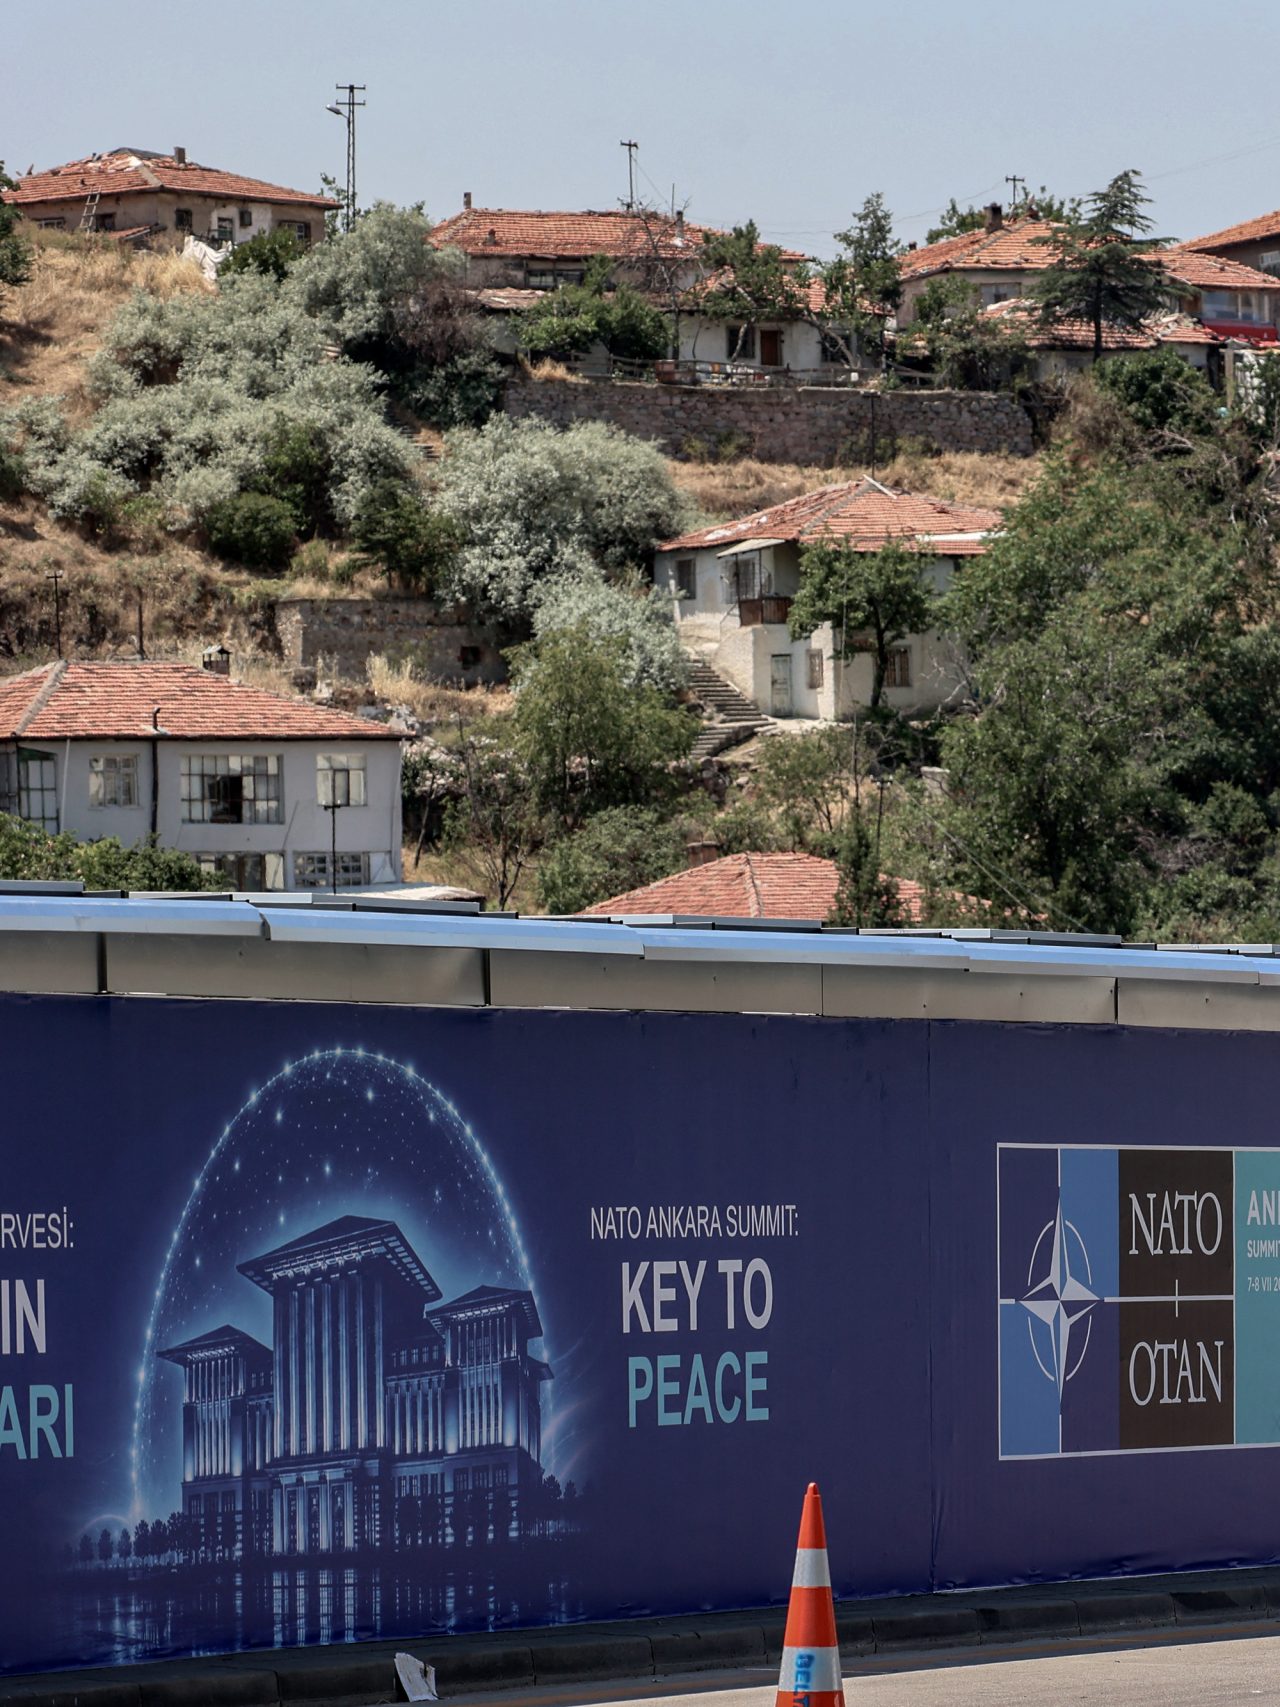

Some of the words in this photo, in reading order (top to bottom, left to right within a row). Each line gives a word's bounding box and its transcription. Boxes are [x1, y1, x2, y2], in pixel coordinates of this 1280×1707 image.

[591, 1206, 641, 1239] NATO
[645, 1205, 722, 1238] ANKARA
[726, 1204, 799, 1237] SUMMIT:
[1128, 1190, 1223, 1256] NATO
[621, 1260, 707, 1333] KEY
[718, 1257, 773, 1330] TO
[1247, 1277, 1260, 1292] 7-8
[1261, 1277, 1272, 1291] VII
[628, 1350, 769, 1428] PEACE
[1128, 1338, 1224, 1406] OTAN
[0, 1383, 74, 1460] ARI
